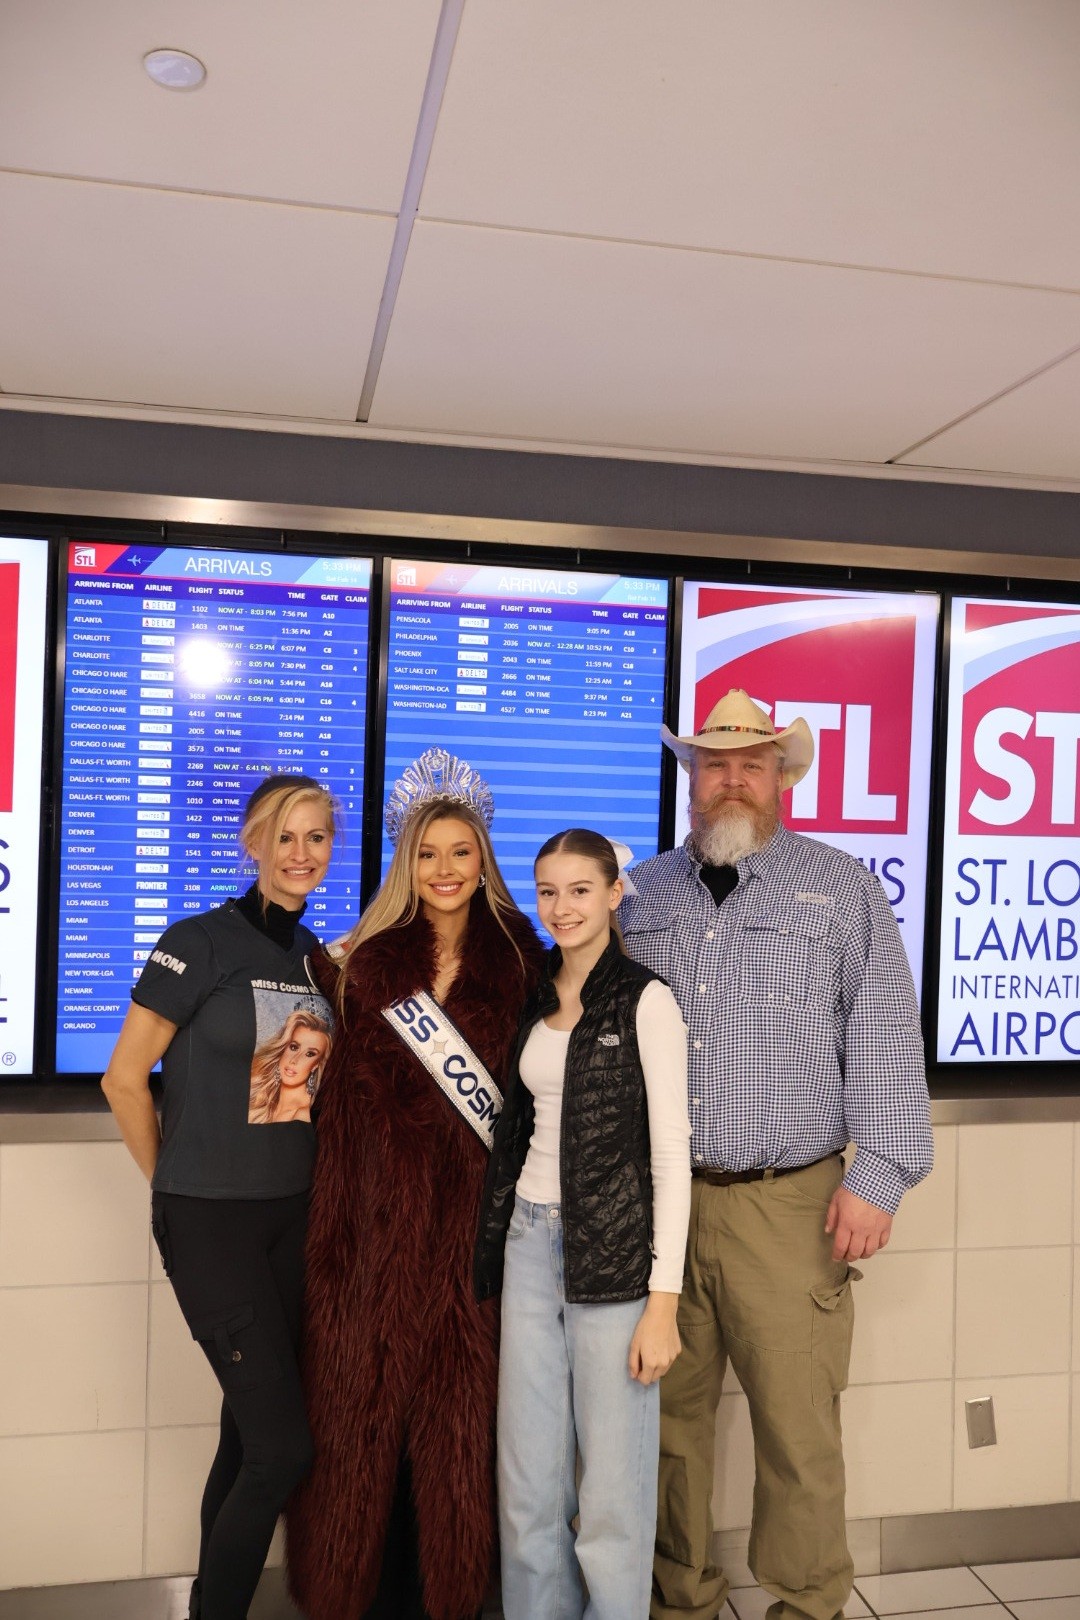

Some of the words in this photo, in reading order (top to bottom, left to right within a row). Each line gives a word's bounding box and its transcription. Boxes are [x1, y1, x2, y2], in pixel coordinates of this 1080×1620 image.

[76, 555, 93, 566] STL
[184, 557, 272, 576] ARRIVALS
[323, 561, 343, 571] 5:33
[346, 562, 361, 572] PM
[399, 574, 414, 584] STL
[74, 580, 110, 588] ARRIVING
[188, 586, 213, 594] FLIGHT
[288, 592, 305, 600] TIME
[498, 576, 578, 595] ARRIVALS
[624, 581, 643, 590] 5:33
[645, 582, 660, 591] PM
[192, 606, 208, 614] 1102
[397, 598, 429, 606] ARRIVING
[461, 602, 486, 610] AIRLINE
[501, 604, 523, 612] FLIGHT
[592, 610, 608, 618] TIME
[623, 612, 638, 620] GATE
[396, 616, 431, 624] PENSACOLA
[192, 622, 208, 630] 1403
[73, 634, 111, 642] CHARLOTTE
[396, 632, 437, 642] PHILADELPHIA
[73, 652, 110, 660] CHARLOTTE
[395, 650, 421, 658] PHOENIX
[394, 684, 449, 692] WASHINGTON-DCA
[71, 704, 102, 712] CHICAGO
[393, 700, 446, 708] WASHINGTON-IAD
[188, 744, 204, 752] 3573
[70, 758, 104, 766] DALLAS-FT.
[750, 698, 897, 821] TL
[968, 706, 1080, 826] ST
[136, 882, 167, 890] FRONTIER
[955, 858, 1011, 906] ST.
[1028, 860, 1080, 906] LO
[954, 916, 1079, 961] LAMB
[150, 950, 187, 975] MOM
[251, 980, 278, 990] MISS
[952, 975, 1080, 999] INTERNATI
[390, 998, 439, 1042] SS
[443, 1055, 500, 1133] COSM
